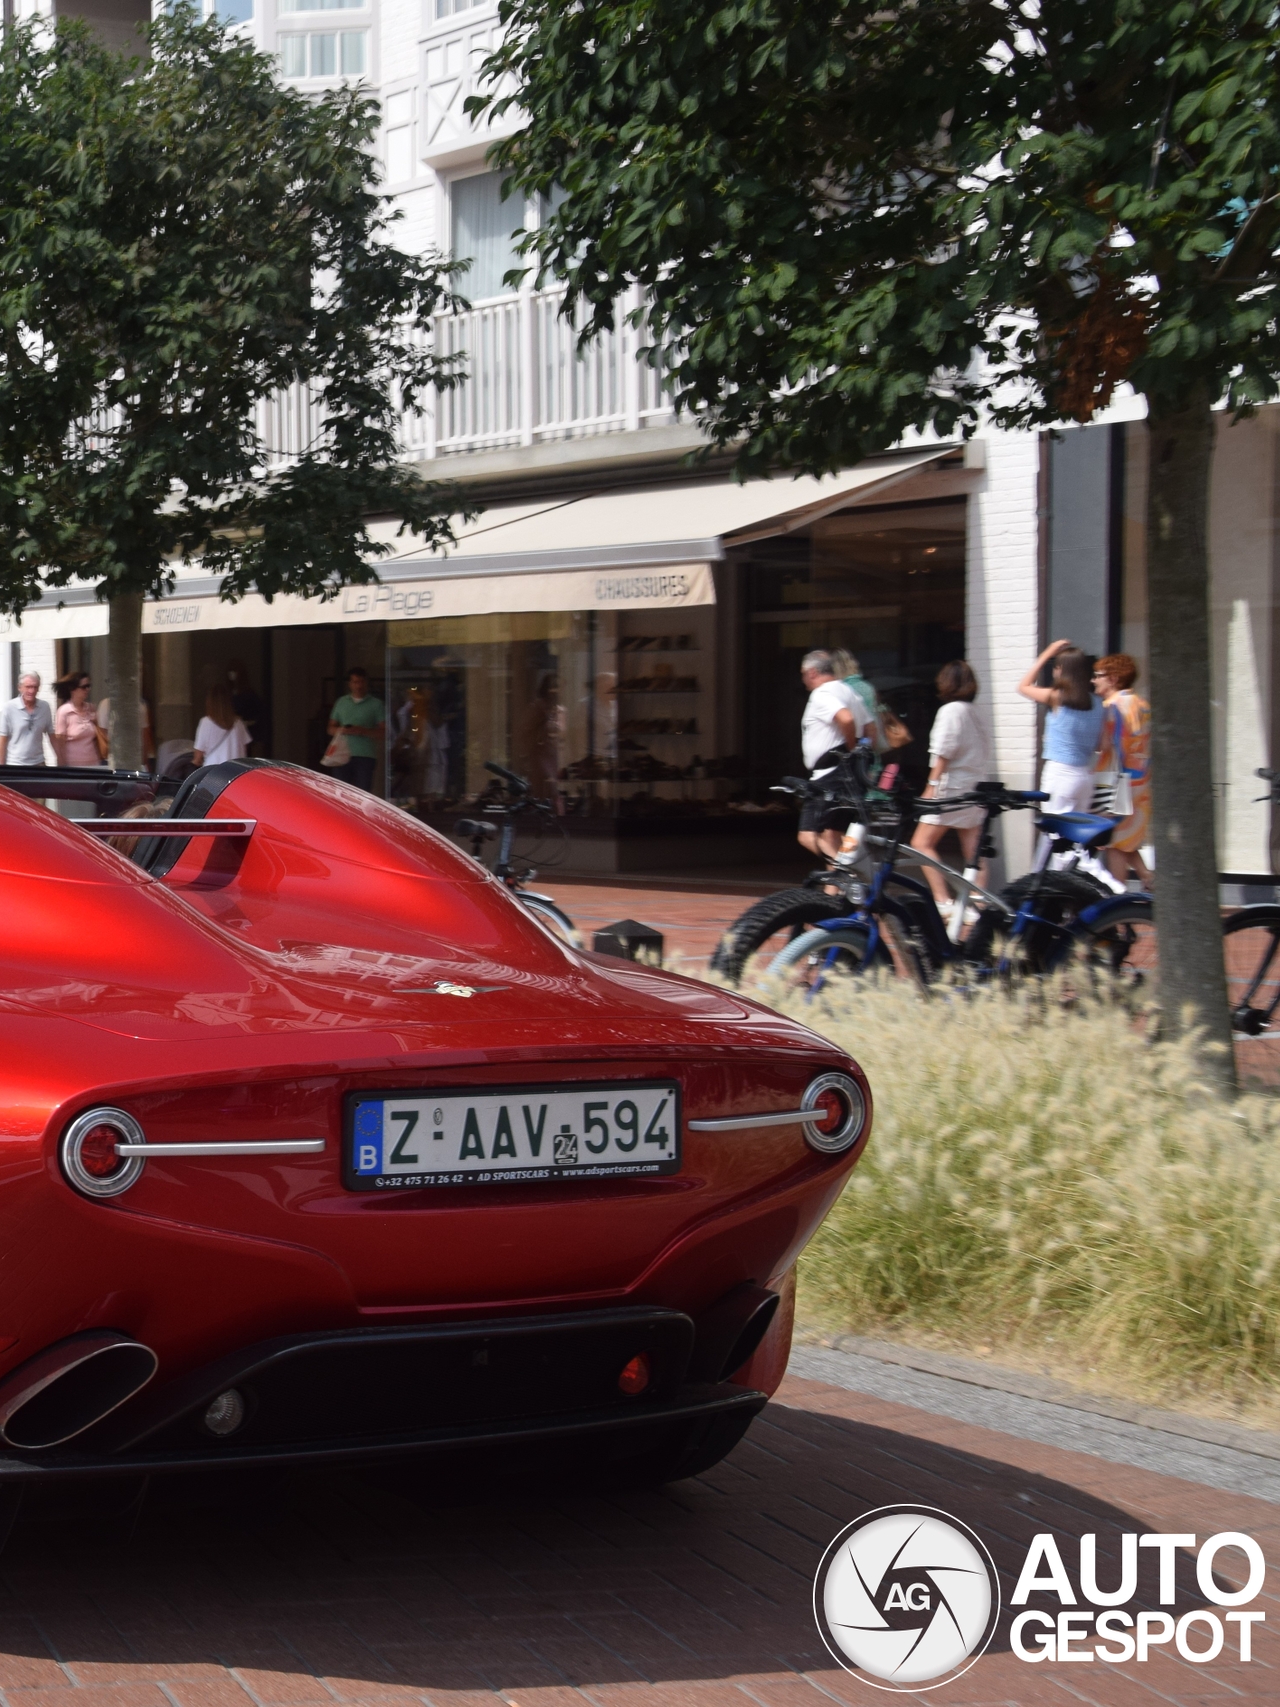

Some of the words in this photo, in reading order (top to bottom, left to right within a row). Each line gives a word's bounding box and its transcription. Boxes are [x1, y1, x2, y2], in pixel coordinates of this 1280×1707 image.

[596, 575, 690, 600] CHAUSSURES
[342, 588, 370, 614] La
[359, 1145, 378, 1170] B
[554, 1135, 578, 1160] 24
[404, 1176, 422, 1186] 475
[424, 1175, 435, 1184] 71
[437, 1175, 450, 1184] 26
[451, 1174, 464, 1183] 42
[477, 1173, 491, 1182] AD
[492, 1170, 550, 1180] SPORTSCARS
[562, 1165, 660, 1176] www.adsportscars.com
